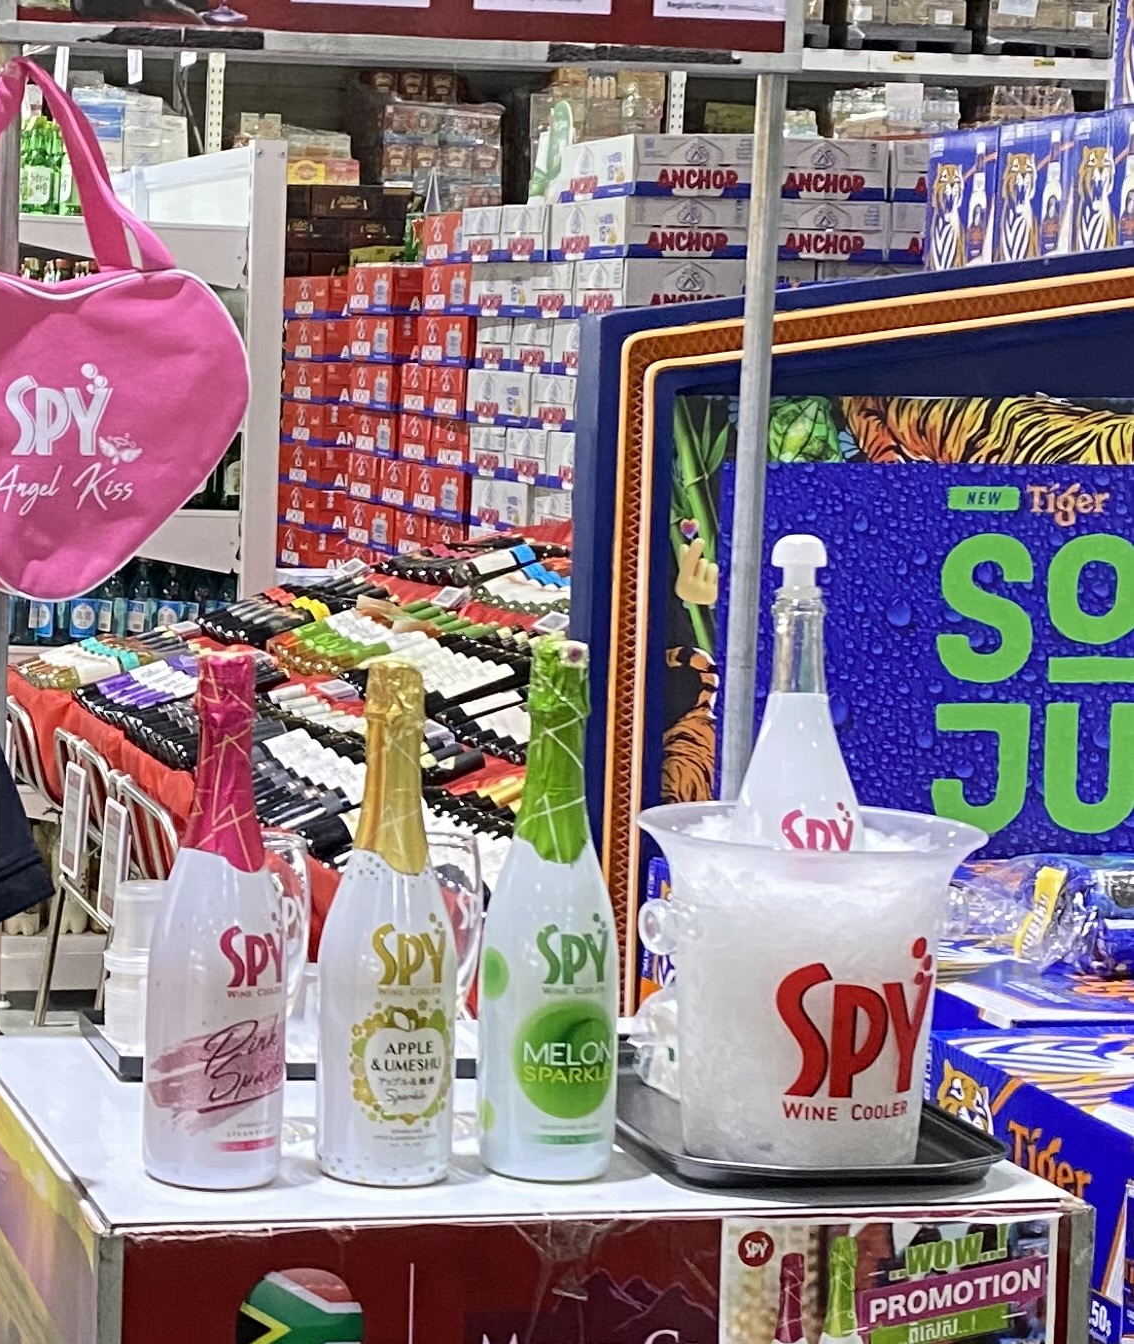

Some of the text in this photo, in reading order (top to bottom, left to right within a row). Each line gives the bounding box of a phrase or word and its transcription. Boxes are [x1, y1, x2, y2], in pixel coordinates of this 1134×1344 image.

[658, 169, 738, 190] ANCHOR
[785, 171, 865, 194] ANCHOR
[646, 230, 729, 252] ANCHOR
[785, 232, 865, 255] ANCHOR
[5, 372, 113, 456] SPY
[72, 461, 134, 511] Kiss
[966, 482, 1110, 527] NEW Tiger
[220, 924, 282, 988] SPY
[372, 922, 446, 986] SPY
[536, 921, 609, 985] SPY
[199, 1013, 279, 1075] Pink
[776, 956, 934, 1098] SPY
[370, 1058, 442, 1072] & UMESHU
[385, 1041, 434, 1056] APPLE
[523, 1040, 612, 1067] MELON
[523, 1065, 610, 1084] SPARKLE
[783, 1100, 908, 1122] WINE COOLER
[1007, 1120, 1095, 1201] Tiger
[744, 1238, 771, 1259] SPY
[869, 1264, 1042, 1324] PROMOTION
